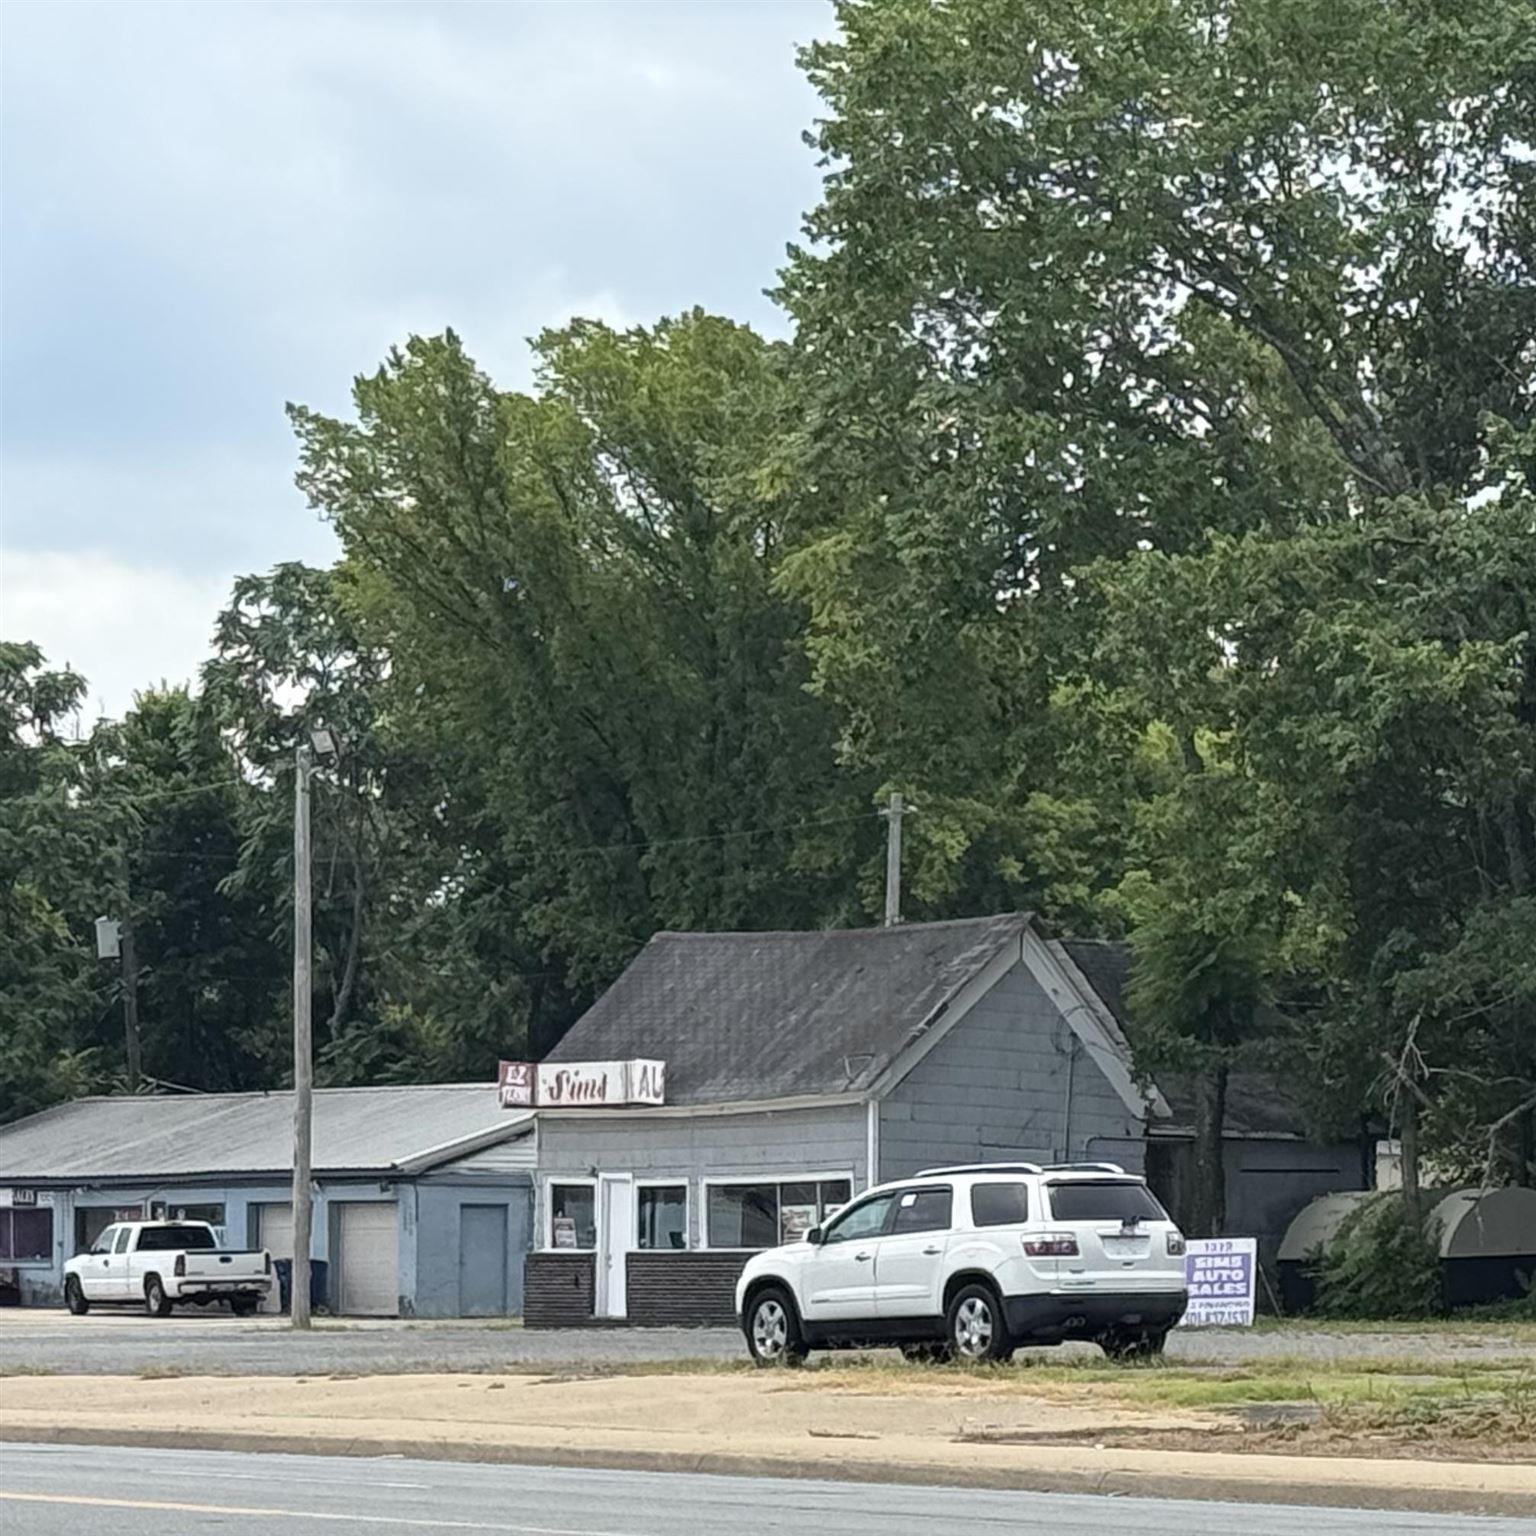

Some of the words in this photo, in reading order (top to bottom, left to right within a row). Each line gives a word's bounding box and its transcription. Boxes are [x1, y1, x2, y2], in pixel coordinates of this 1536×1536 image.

[1195, 1256, 1243, 1268] SIMS
[1193, 1269, 1244, 1282] AUTO
[1187, 1282, 1247, 1296] SALES
